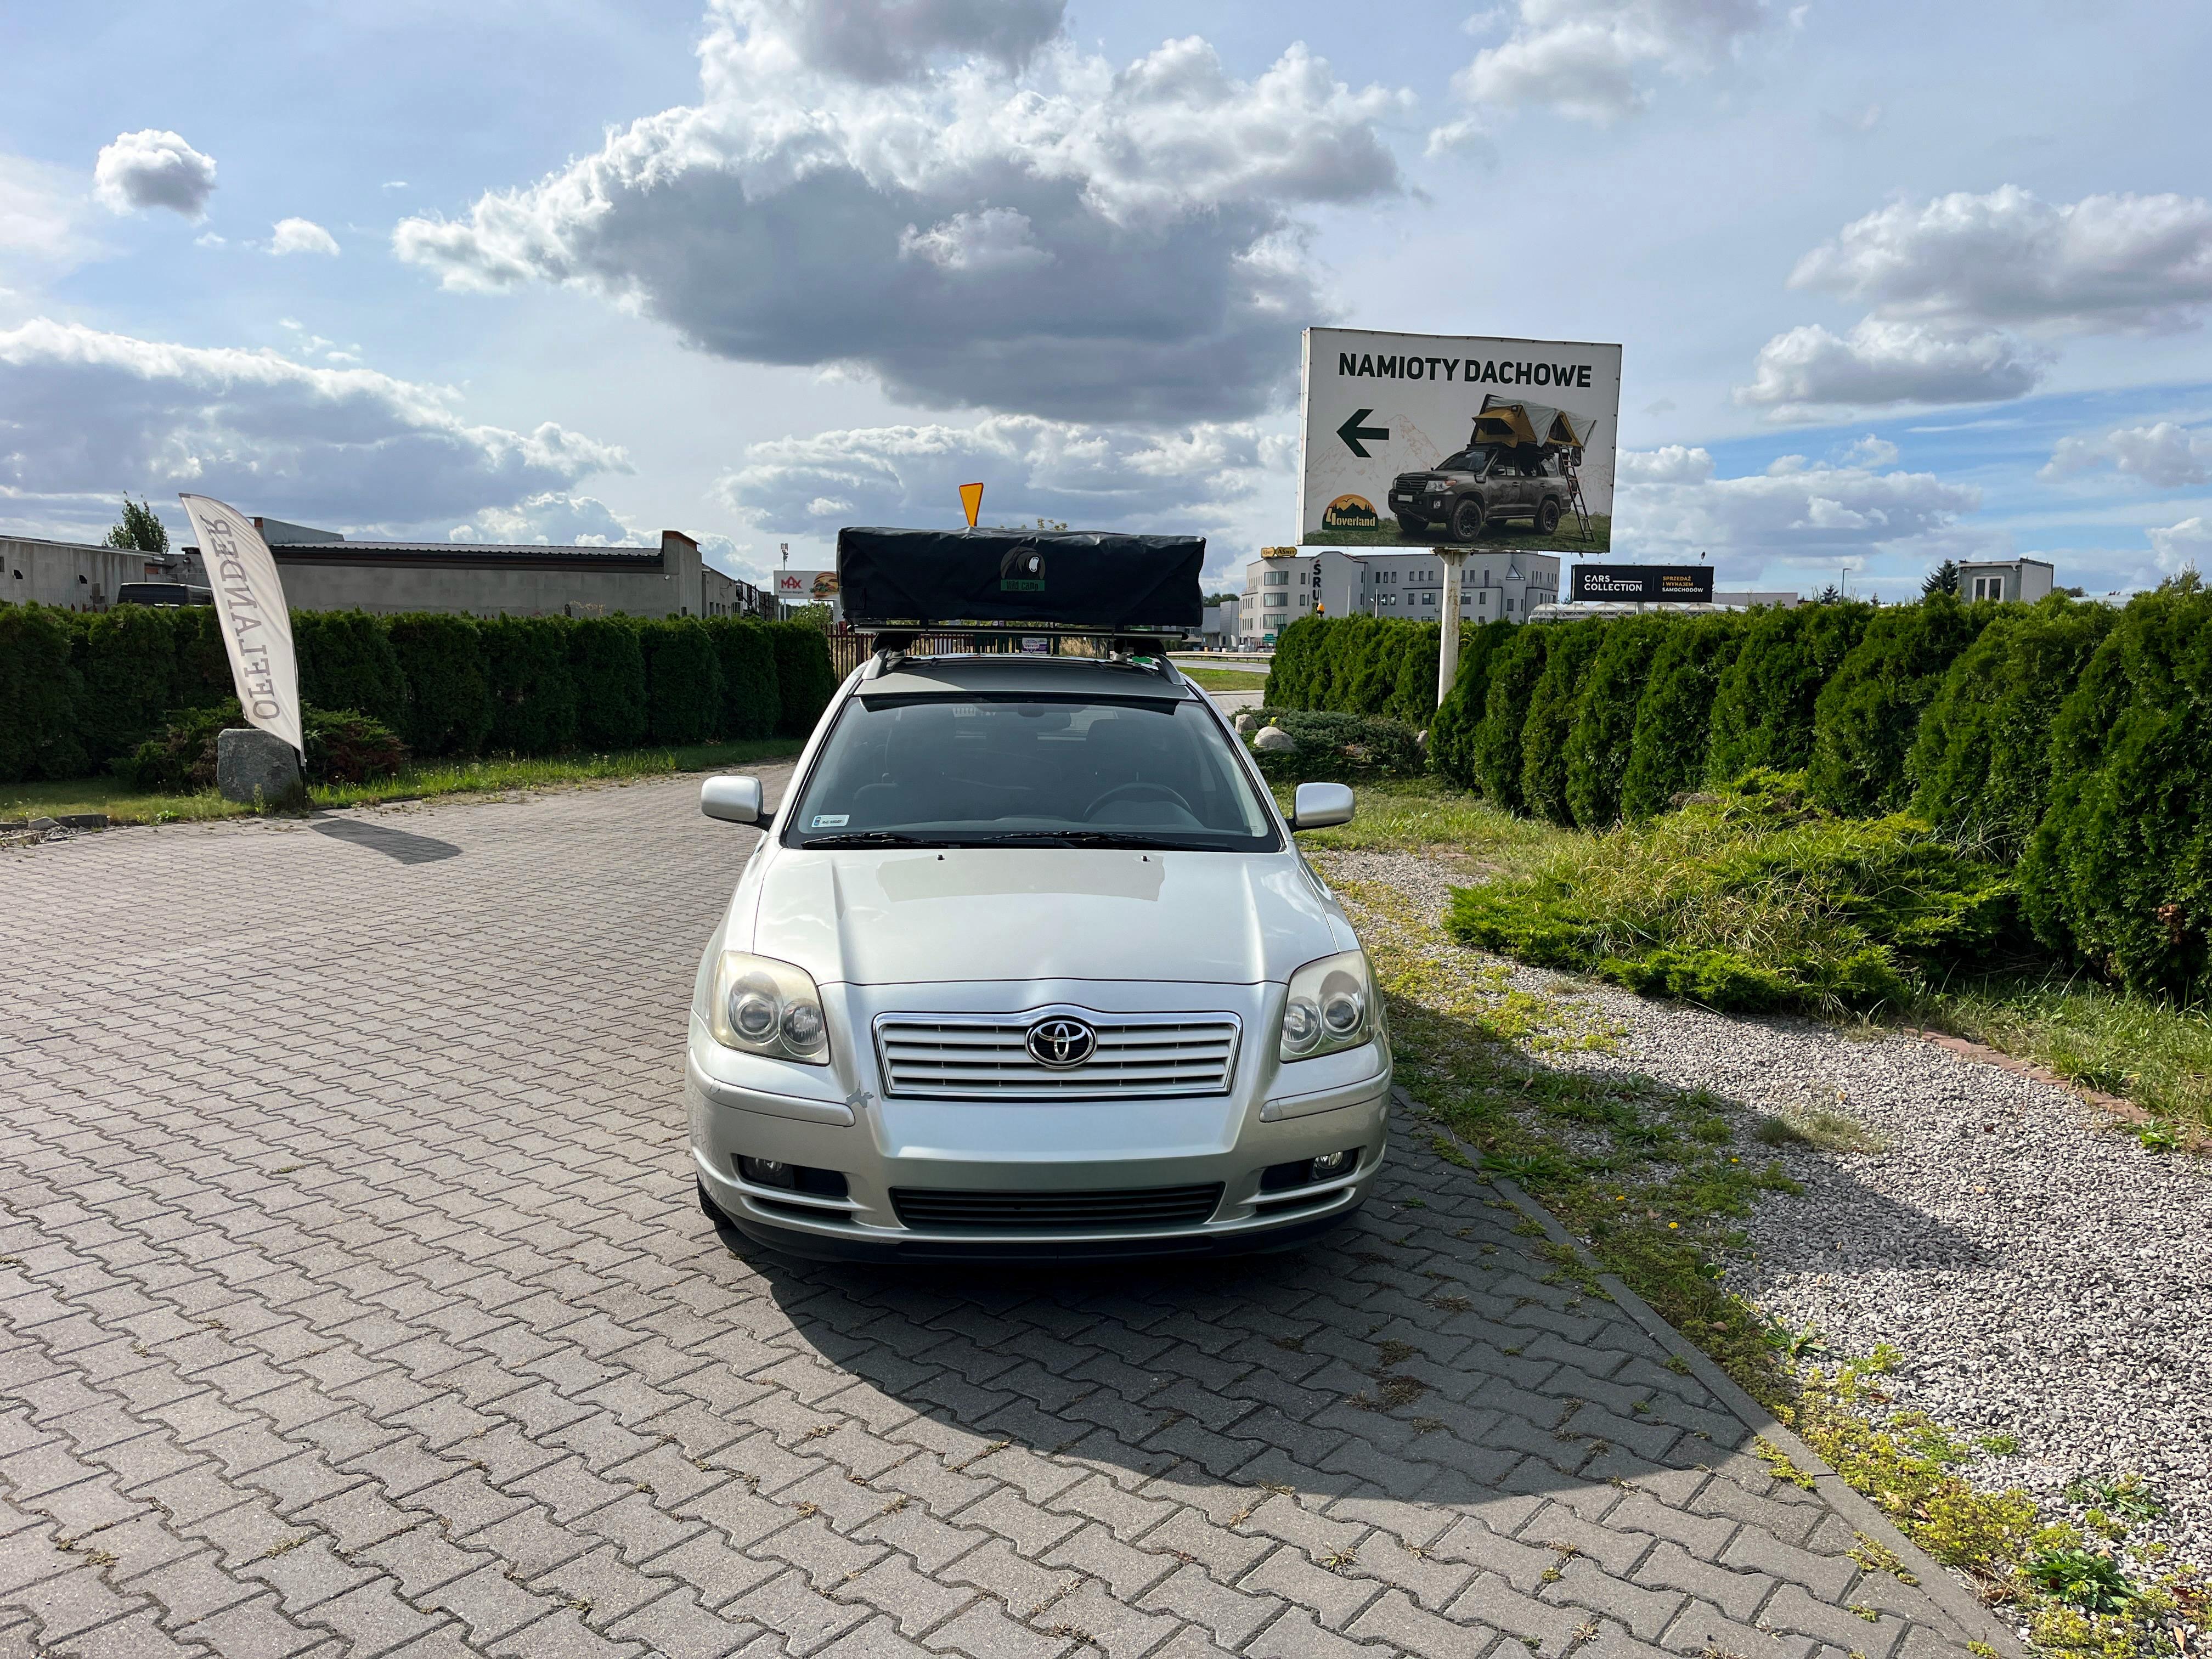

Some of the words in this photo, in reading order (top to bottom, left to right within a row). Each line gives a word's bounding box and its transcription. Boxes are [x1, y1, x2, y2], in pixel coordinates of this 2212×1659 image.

[1339, 352, 1460, 381] NAMIOTY
[1464, 359, 1592, 387] DACHOWE
[781, 575, 803, 589] MAX
[1584, 574, 1610, 583] CARS
[1584, 583, 1643, 592] COLLECTION
